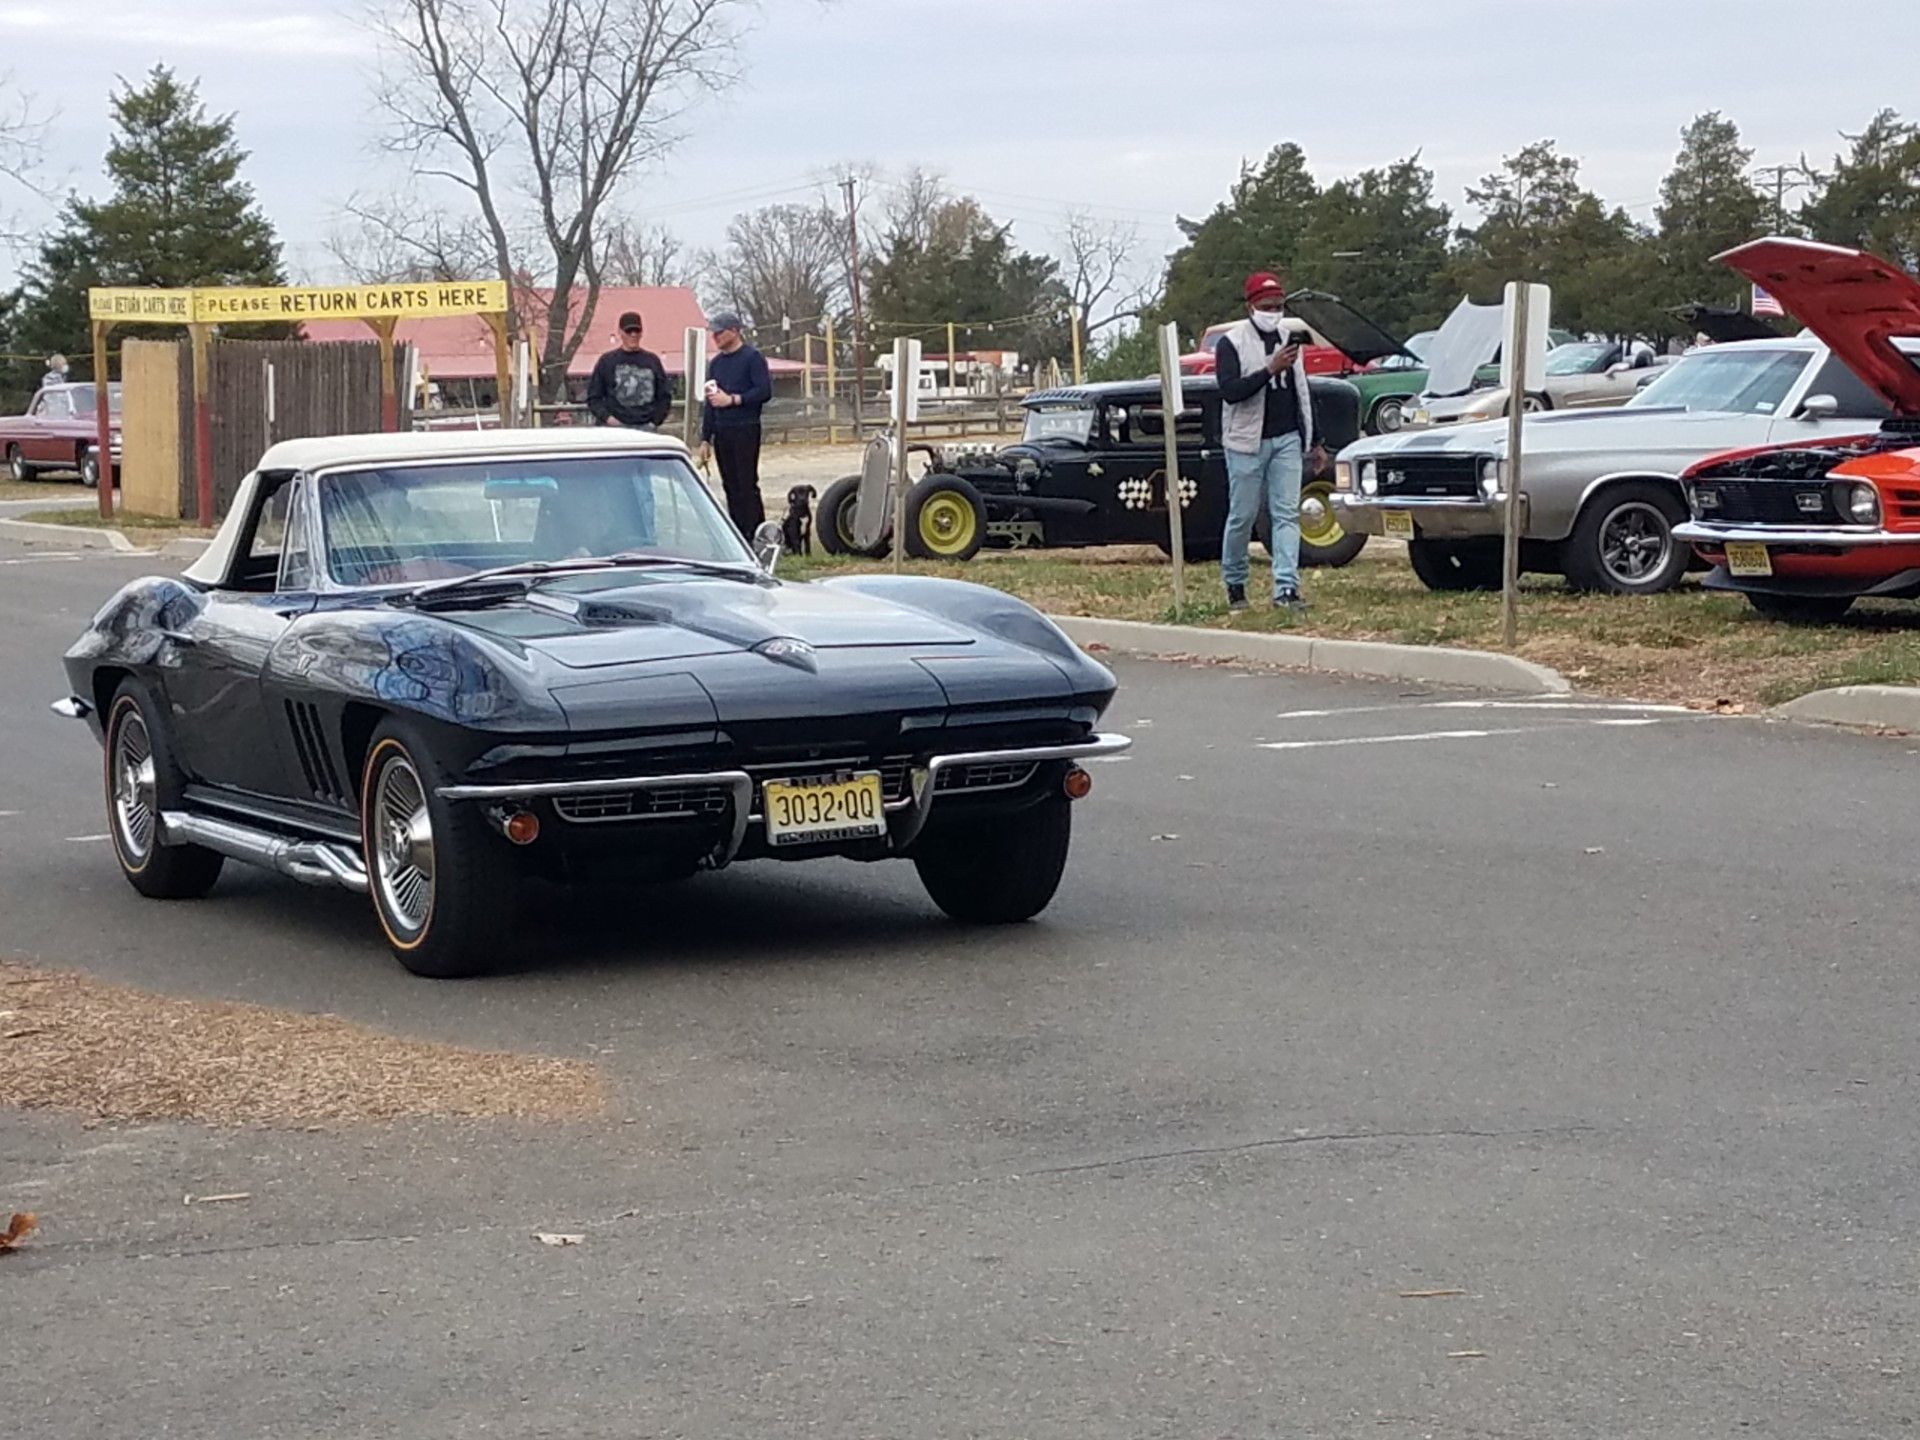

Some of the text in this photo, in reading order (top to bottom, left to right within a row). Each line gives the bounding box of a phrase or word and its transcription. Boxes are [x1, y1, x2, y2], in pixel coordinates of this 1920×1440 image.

[115, 296, 140, 313] RETURN
[143, 296, 166, 313] CARTS
[168, 297, 187, 315] HERE
[208, 288, 488, 312] PLEASE RETURN CARTS HERE
